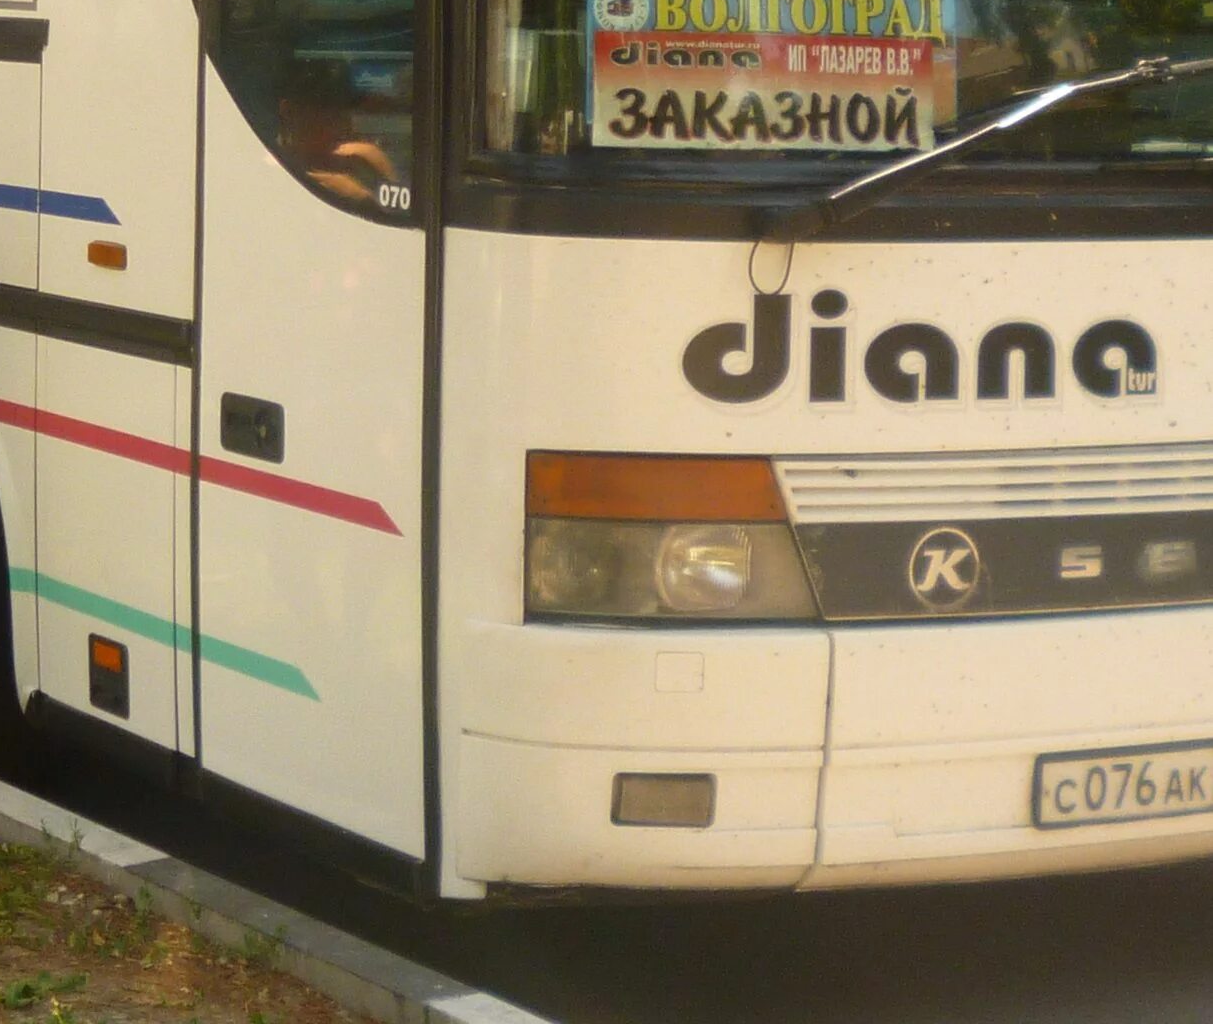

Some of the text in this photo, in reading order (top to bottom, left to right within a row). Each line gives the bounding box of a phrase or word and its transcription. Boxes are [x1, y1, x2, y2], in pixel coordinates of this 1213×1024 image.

[609, 40, 763, 70] diana
[788, 44, 807, 73] ИП
[608, 86, 921, 147] ЗАКАЗНОЙ
[379, 183, 411, 210] 070
[682, 288, 1158, 404] diana
[919, 547, 973, 592] K
